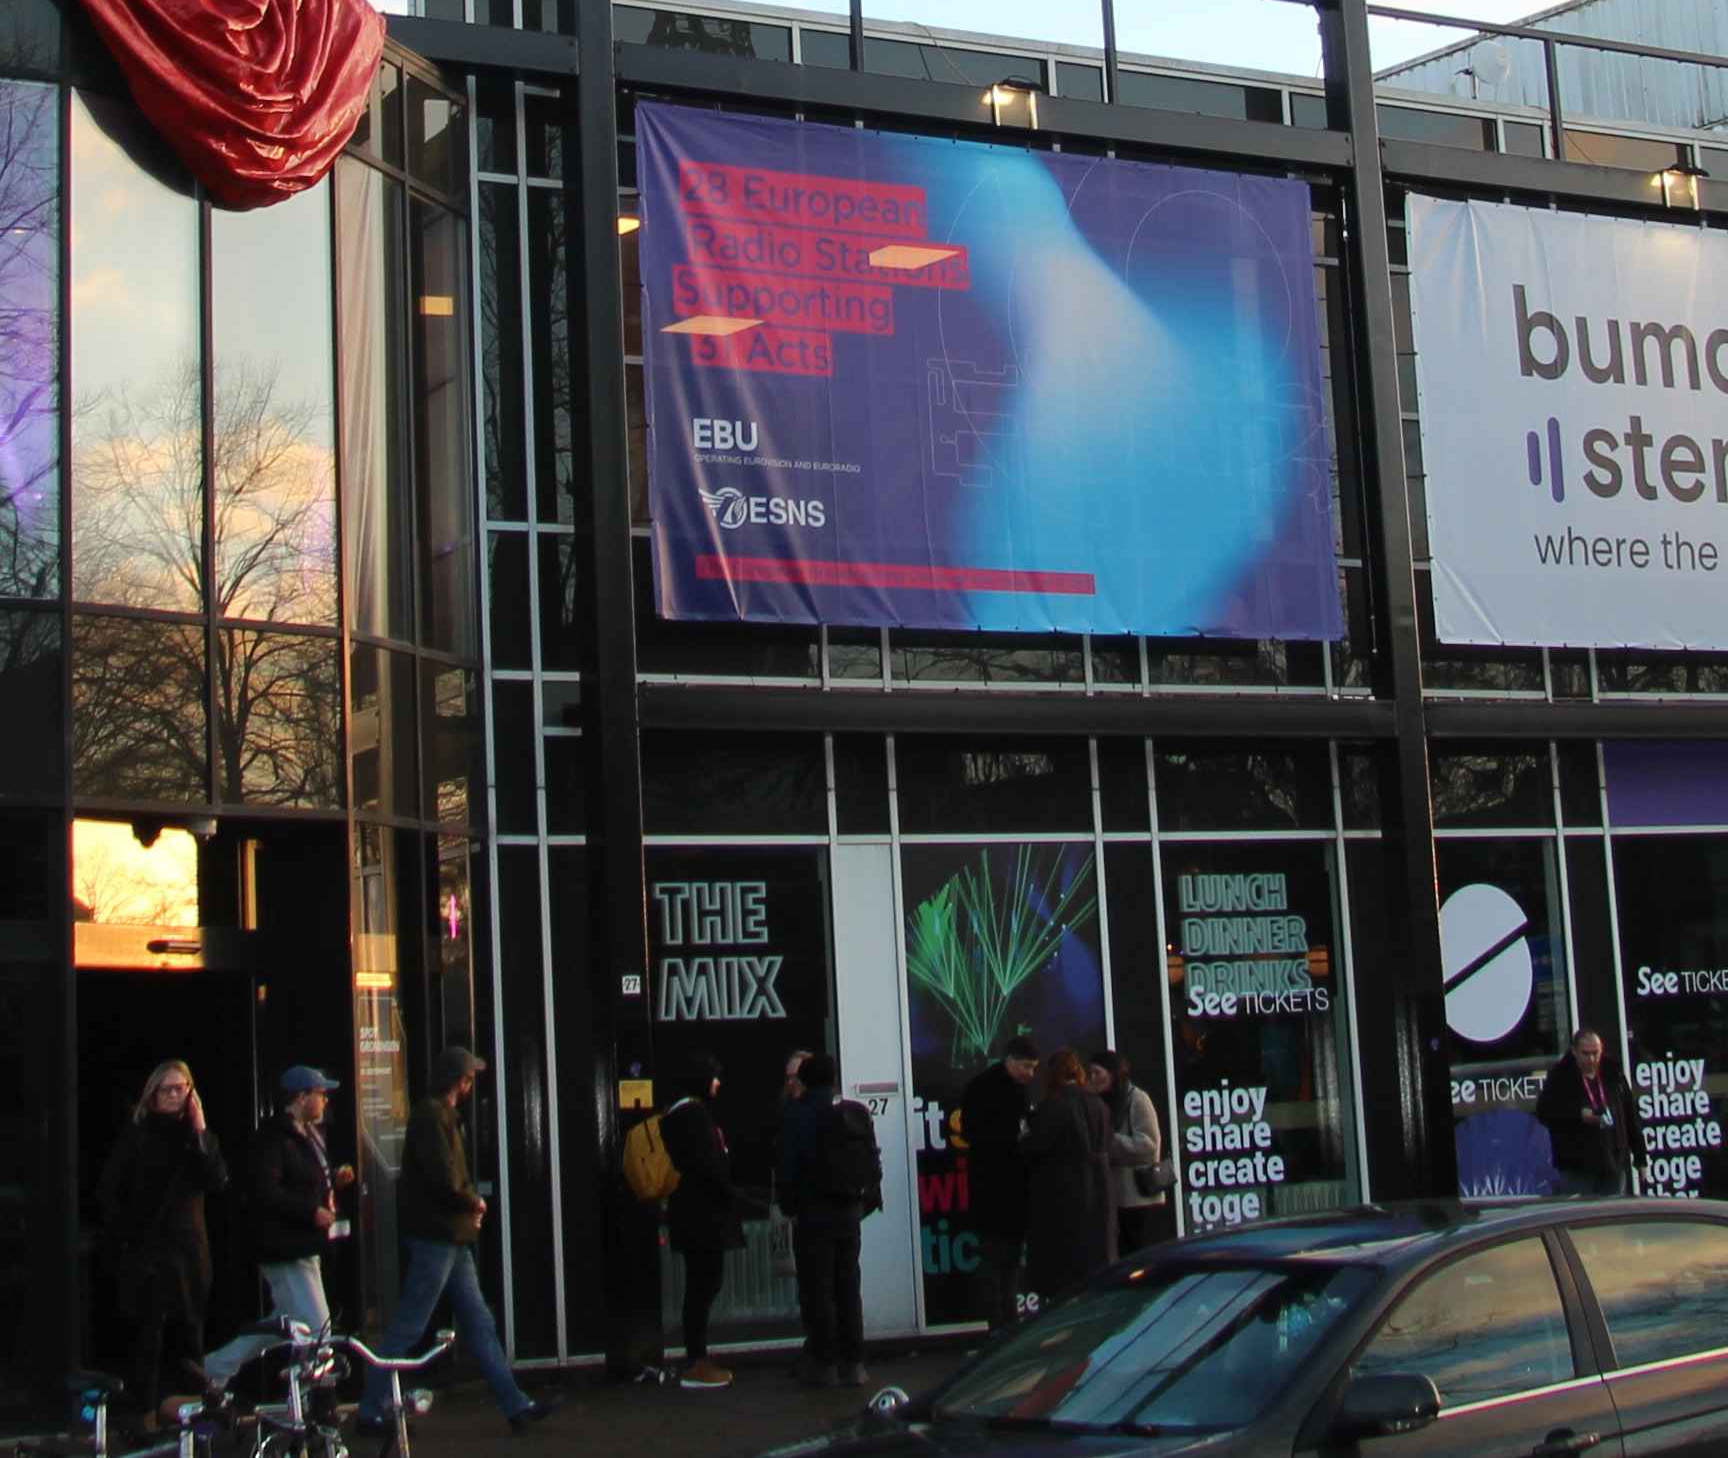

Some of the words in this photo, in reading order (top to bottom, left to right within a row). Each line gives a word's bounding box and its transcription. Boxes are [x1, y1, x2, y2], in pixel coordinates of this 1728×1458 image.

[744, 175, 924, 226] European
[690, 223, 800, 262] Radio
[747, 332, 829, 370] Acts
[693, 418, 759, 451] EBU
[744, 456, 792, 469] EUROVISION
[794, 460, 812, 471] AND
[813, 461, 861, 473] EURORADIO
[750, 497, 825, 527] ESNS
[1534, 526, 1650, 569] where
[1660, 531, 1718, 572] the
[1178, 873, 1287, 912] LUNCH
[655, 882, 768, 945] THE
[1182, 916, 1309, 956] DINNER
[623, 977, 638, 991] 27
[659, 956, 787, 1021] MIX
[1185, 958, 1312, 999] DRINKS
[1636, 966, 1679, 996] See
[1187, 985, 1237, 1017] See
[1240, 987, 1329, 1015] TICKETS
[1478, 1076, 1547, 1103] TICKET
[1635, 1051, 1705, 1093] enjoy
[869, 1099, 888, 1115] 27
[1184, 1078, 1267, 1124] enjoy
[1638, 1086, 1710, 1119] share
[1186, 1116, 1272, 1152] share
[1642, 1117, 1721, 1151] create
[1188, 1150, 1285, 1188] create
[1646, 1154, 1702, 1190] toge
[1189, 1191, 1260, 1226] toge
